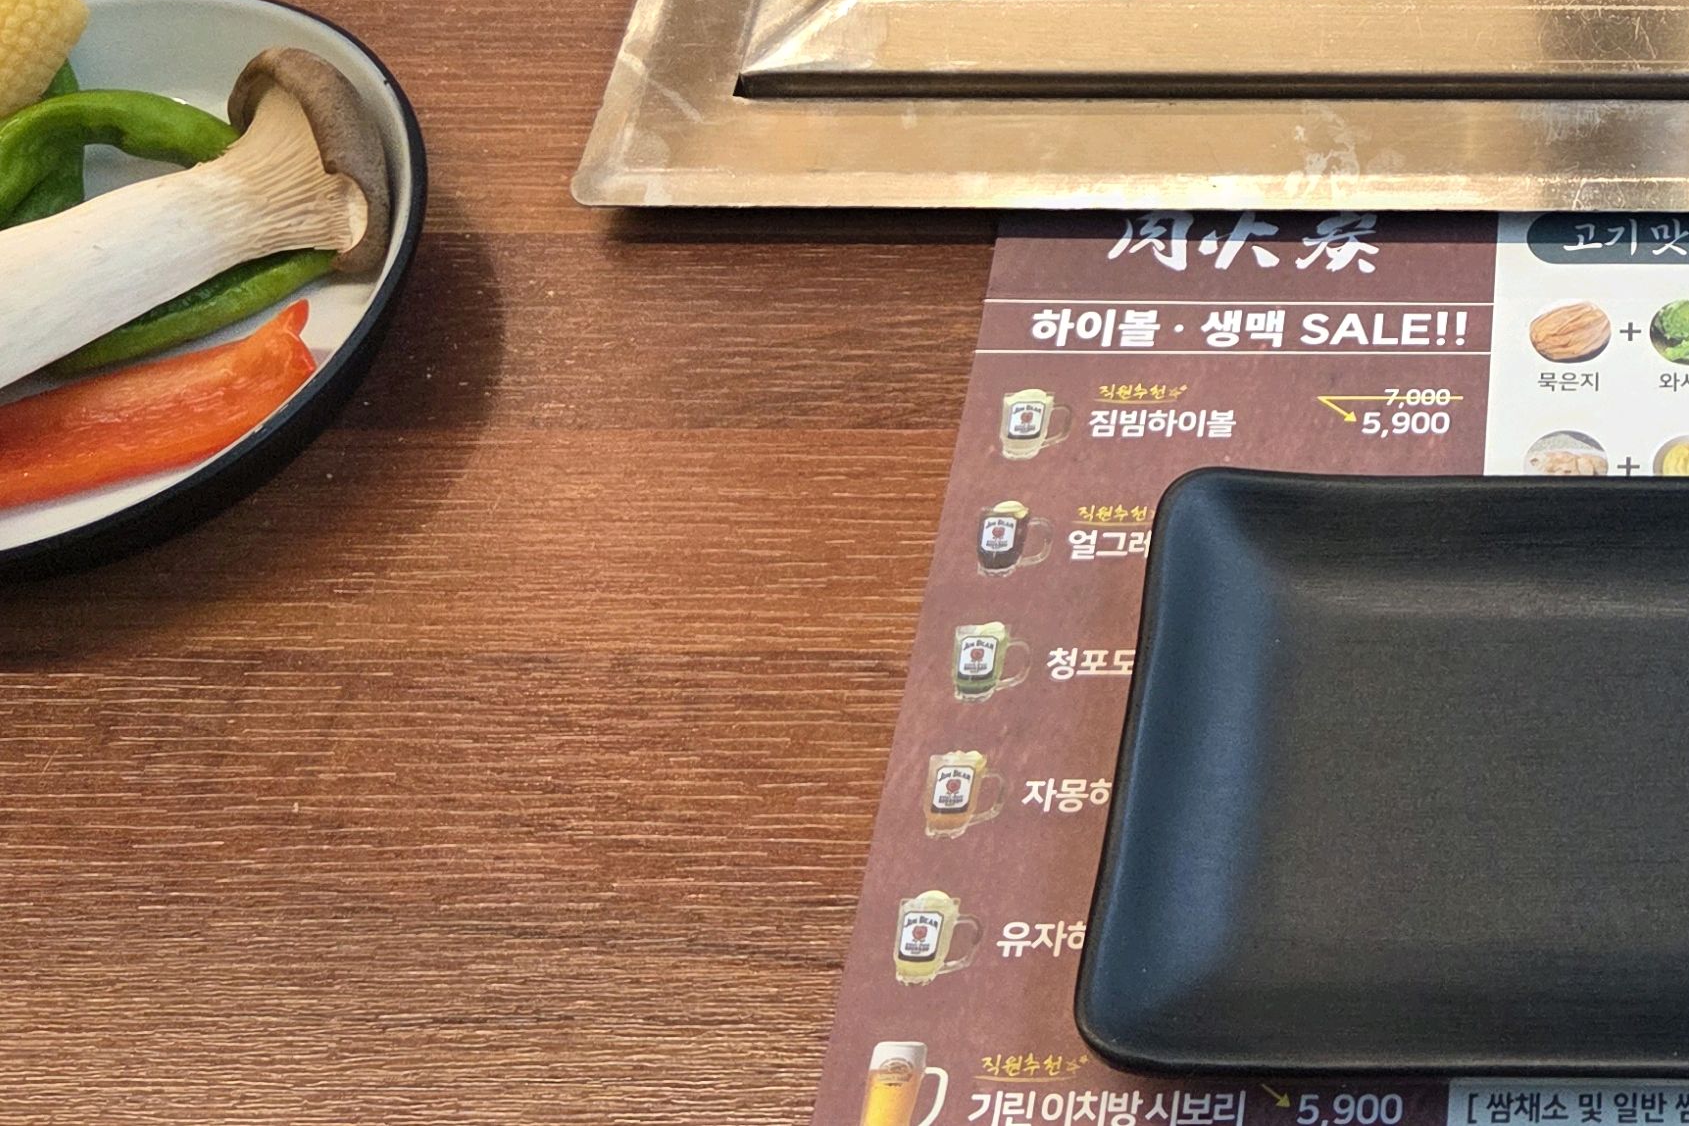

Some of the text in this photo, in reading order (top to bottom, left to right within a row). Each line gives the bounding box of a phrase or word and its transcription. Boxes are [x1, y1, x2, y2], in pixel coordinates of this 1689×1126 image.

[1563, 218, 1638, 256] 고기
[1030, 309, 1160, 348] 하이볼
[1201, 309, 1286, 348] 생맥
[1300, 311, 1467, 347] SALE!!
[1384, 389, 1451, 408] 7,000
[1537, 372, 1600, 393] 묵은지
[1089, 409, 1450, 438] 짐빔하이볼 5,900
[1297, 1094, 1404, 1126] 5,900
[1486, 1091, 1569, 1124] 쌈채소
[1578, 1092, 1603, 1124] 및
[1613, 1092, 1667, 1124] 일반
